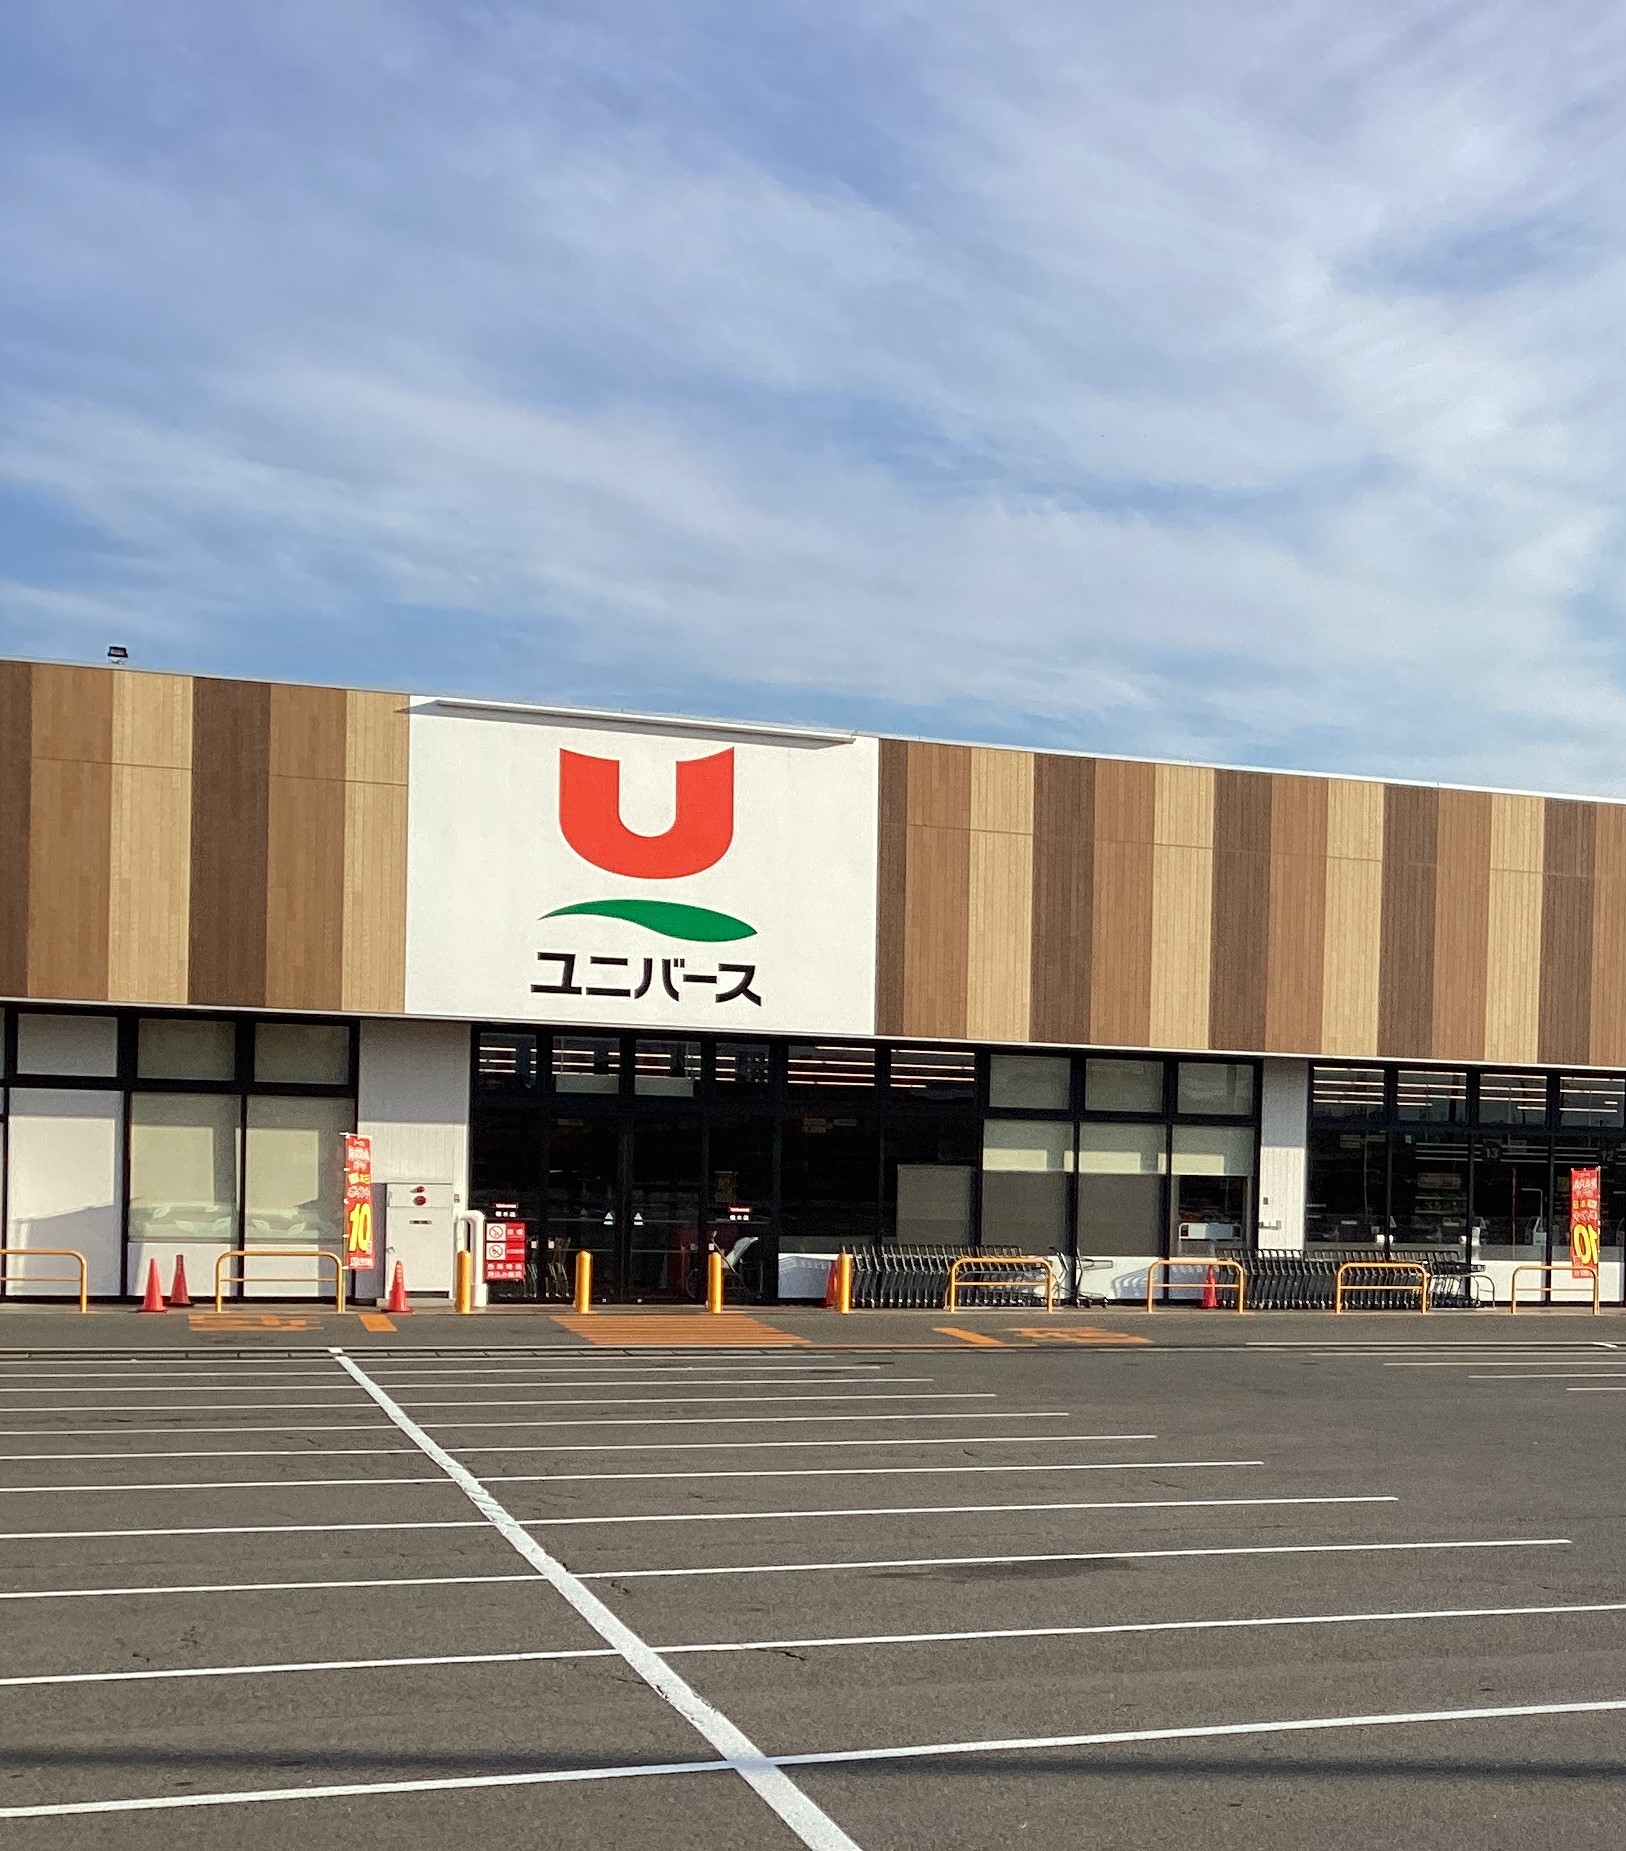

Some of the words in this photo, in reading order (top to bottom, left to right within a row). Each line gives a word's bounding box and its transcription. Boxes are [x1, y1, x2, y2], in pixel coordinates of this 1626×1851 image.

[560, 748, 735, 880] U
[530, 951, 762, 1007] ユニバース
[349, 1203, 372, 1252] 10
